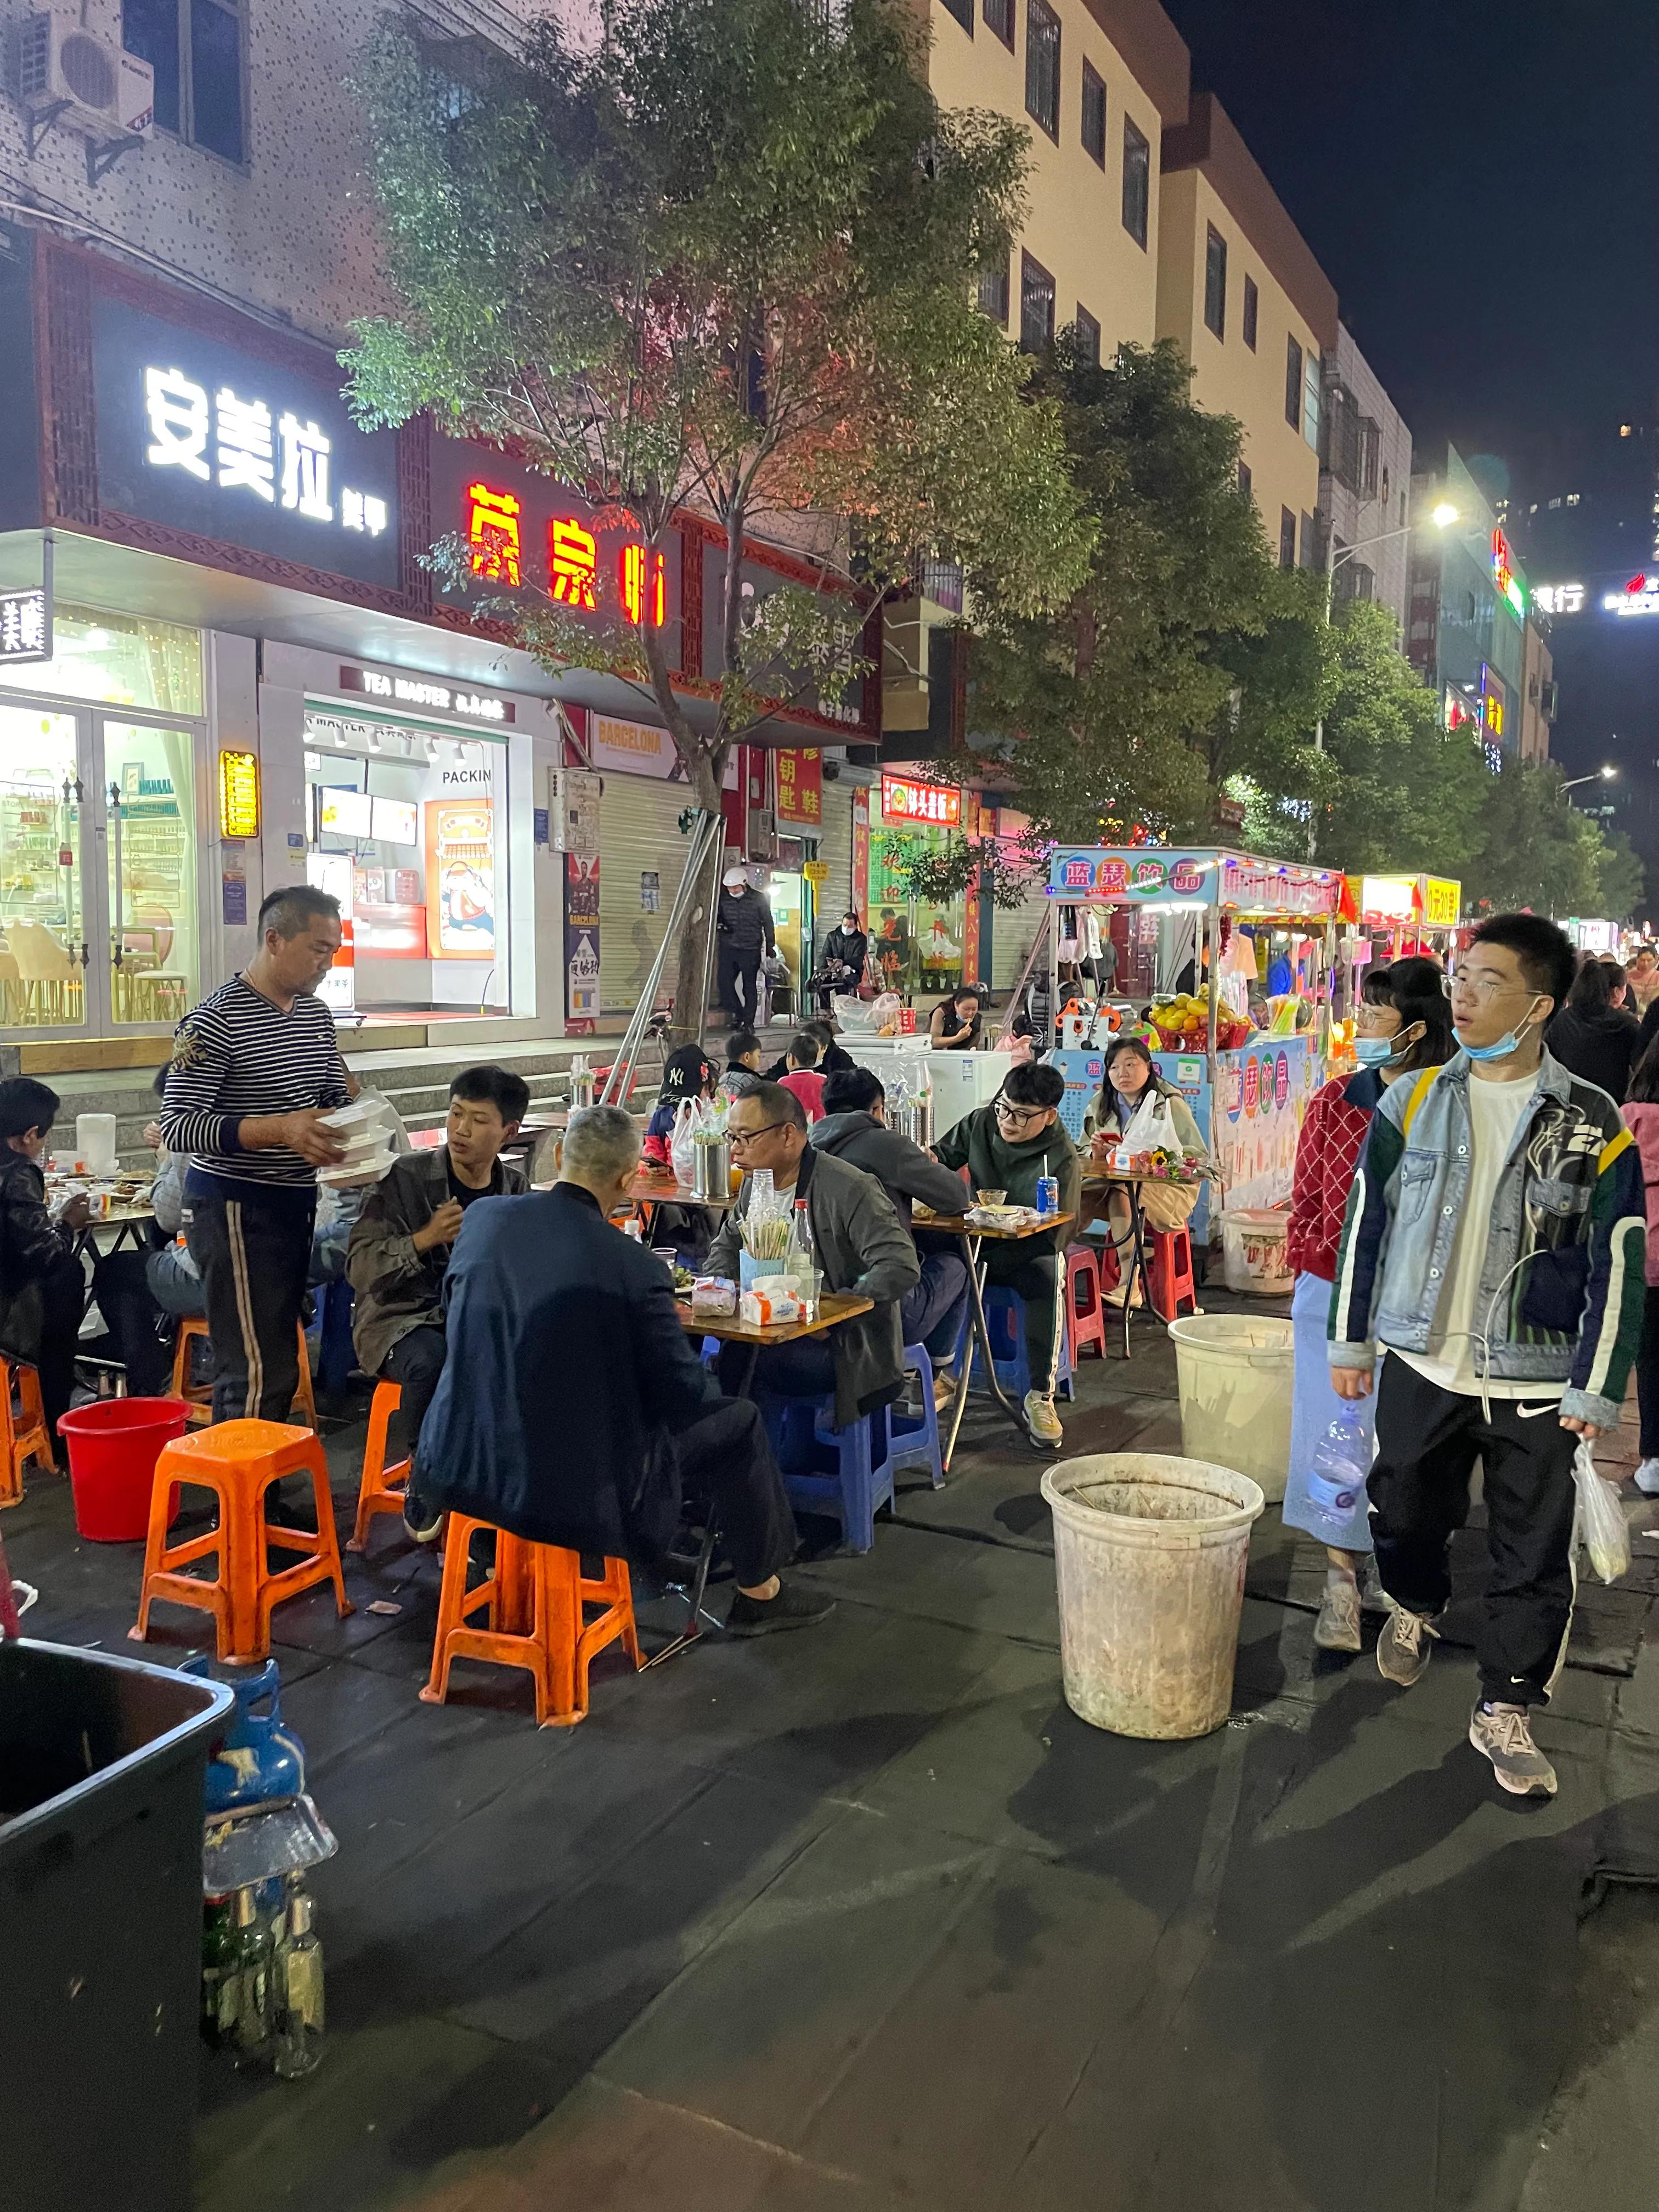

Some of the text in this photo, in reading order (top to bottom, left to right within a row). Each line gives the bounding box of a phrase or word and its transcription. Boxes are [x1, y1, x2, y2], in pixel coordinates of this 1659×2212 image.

[146, 366, 333, 522] 安美拉
[363, 671, 392, 697] TEA
[394, 678, 450, 708] MASTER
[598, 720, 662, 755] BARCELONA
[1066, 861, 1201, 890] 蓝瑟饮品
[669, 1068, 684, 1086] NY
